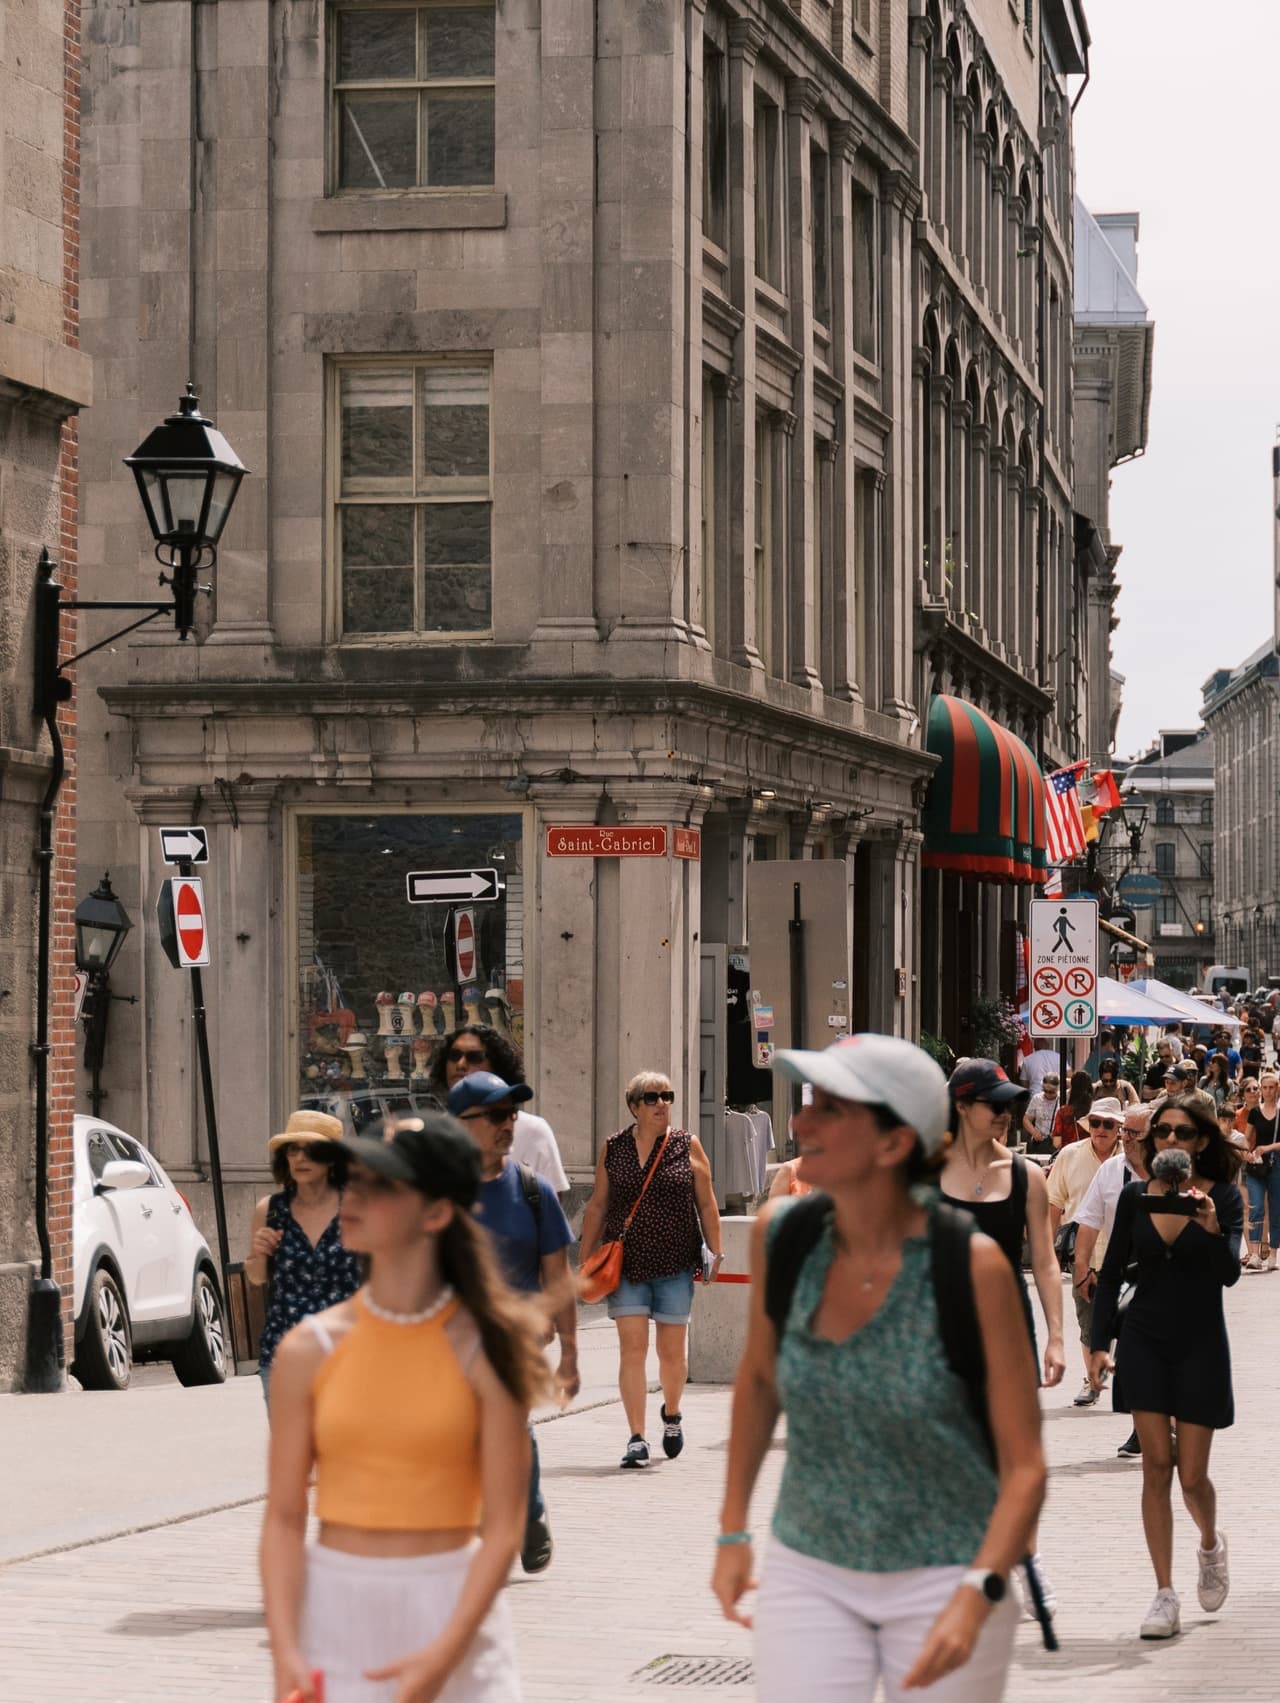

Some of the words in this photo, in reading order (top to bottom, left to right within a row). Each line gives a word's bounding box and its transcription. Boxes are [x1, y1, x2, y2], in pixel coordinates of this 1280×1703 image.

[600, 830, 614, 838] Rue
[557, 837, 656, 851] Saint-Gabriel
[1037, 955, 1055, 964] ZONE
[1057, 953, 1090, 964] PIÉTONNE
